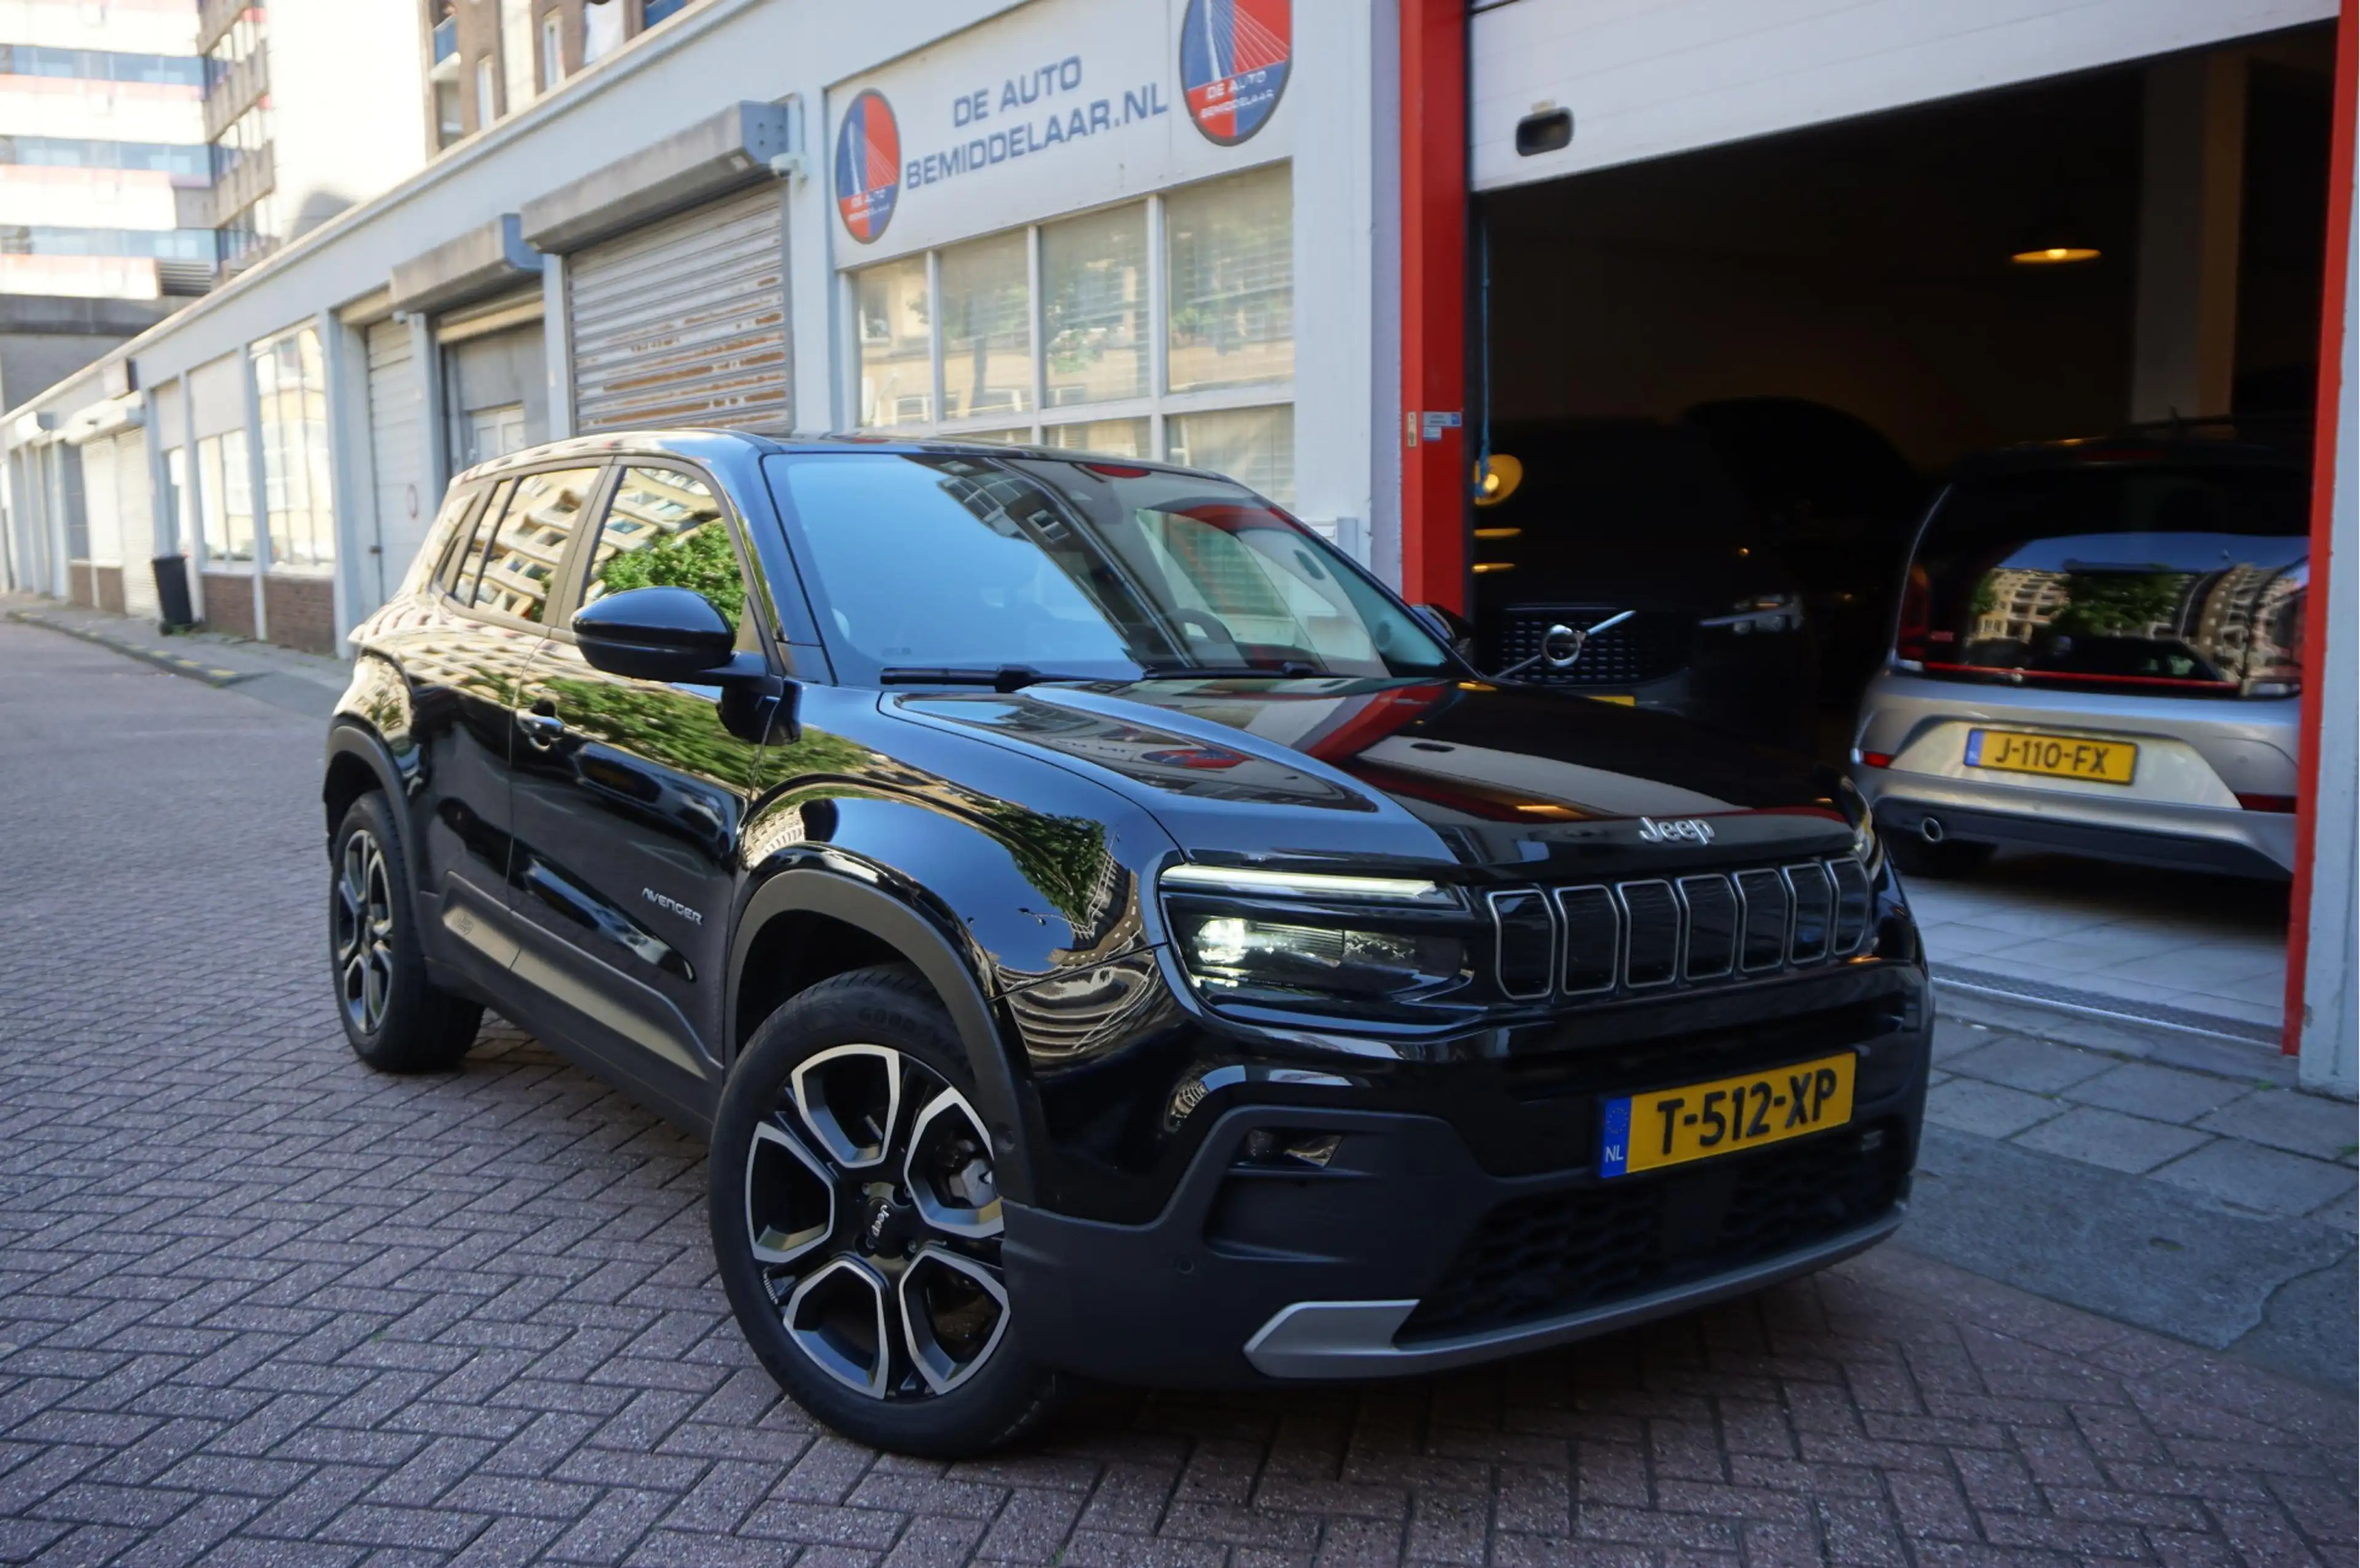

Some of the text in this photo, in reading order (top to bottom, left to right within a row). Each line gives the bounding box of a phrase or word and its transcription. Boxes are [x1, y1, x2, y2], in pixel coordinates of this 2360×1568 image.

[953, 55, 1082, 128] DE AUTO
[1205, 82, 1225, 101] DE
[906, 82, 1168, 190] BEMIDDELAAR.NL
[1995, 737, 2110, 775] J-110-FX
[1639, 817, 1715, 845] Jeep
[642, 887, 704, 925] AVENGER
[1657, 1068, 1836, 1156] T-512-XP
[1605, 1145, 1624, 1163] NL
[871, 1204, 889, 1237] Jeep
